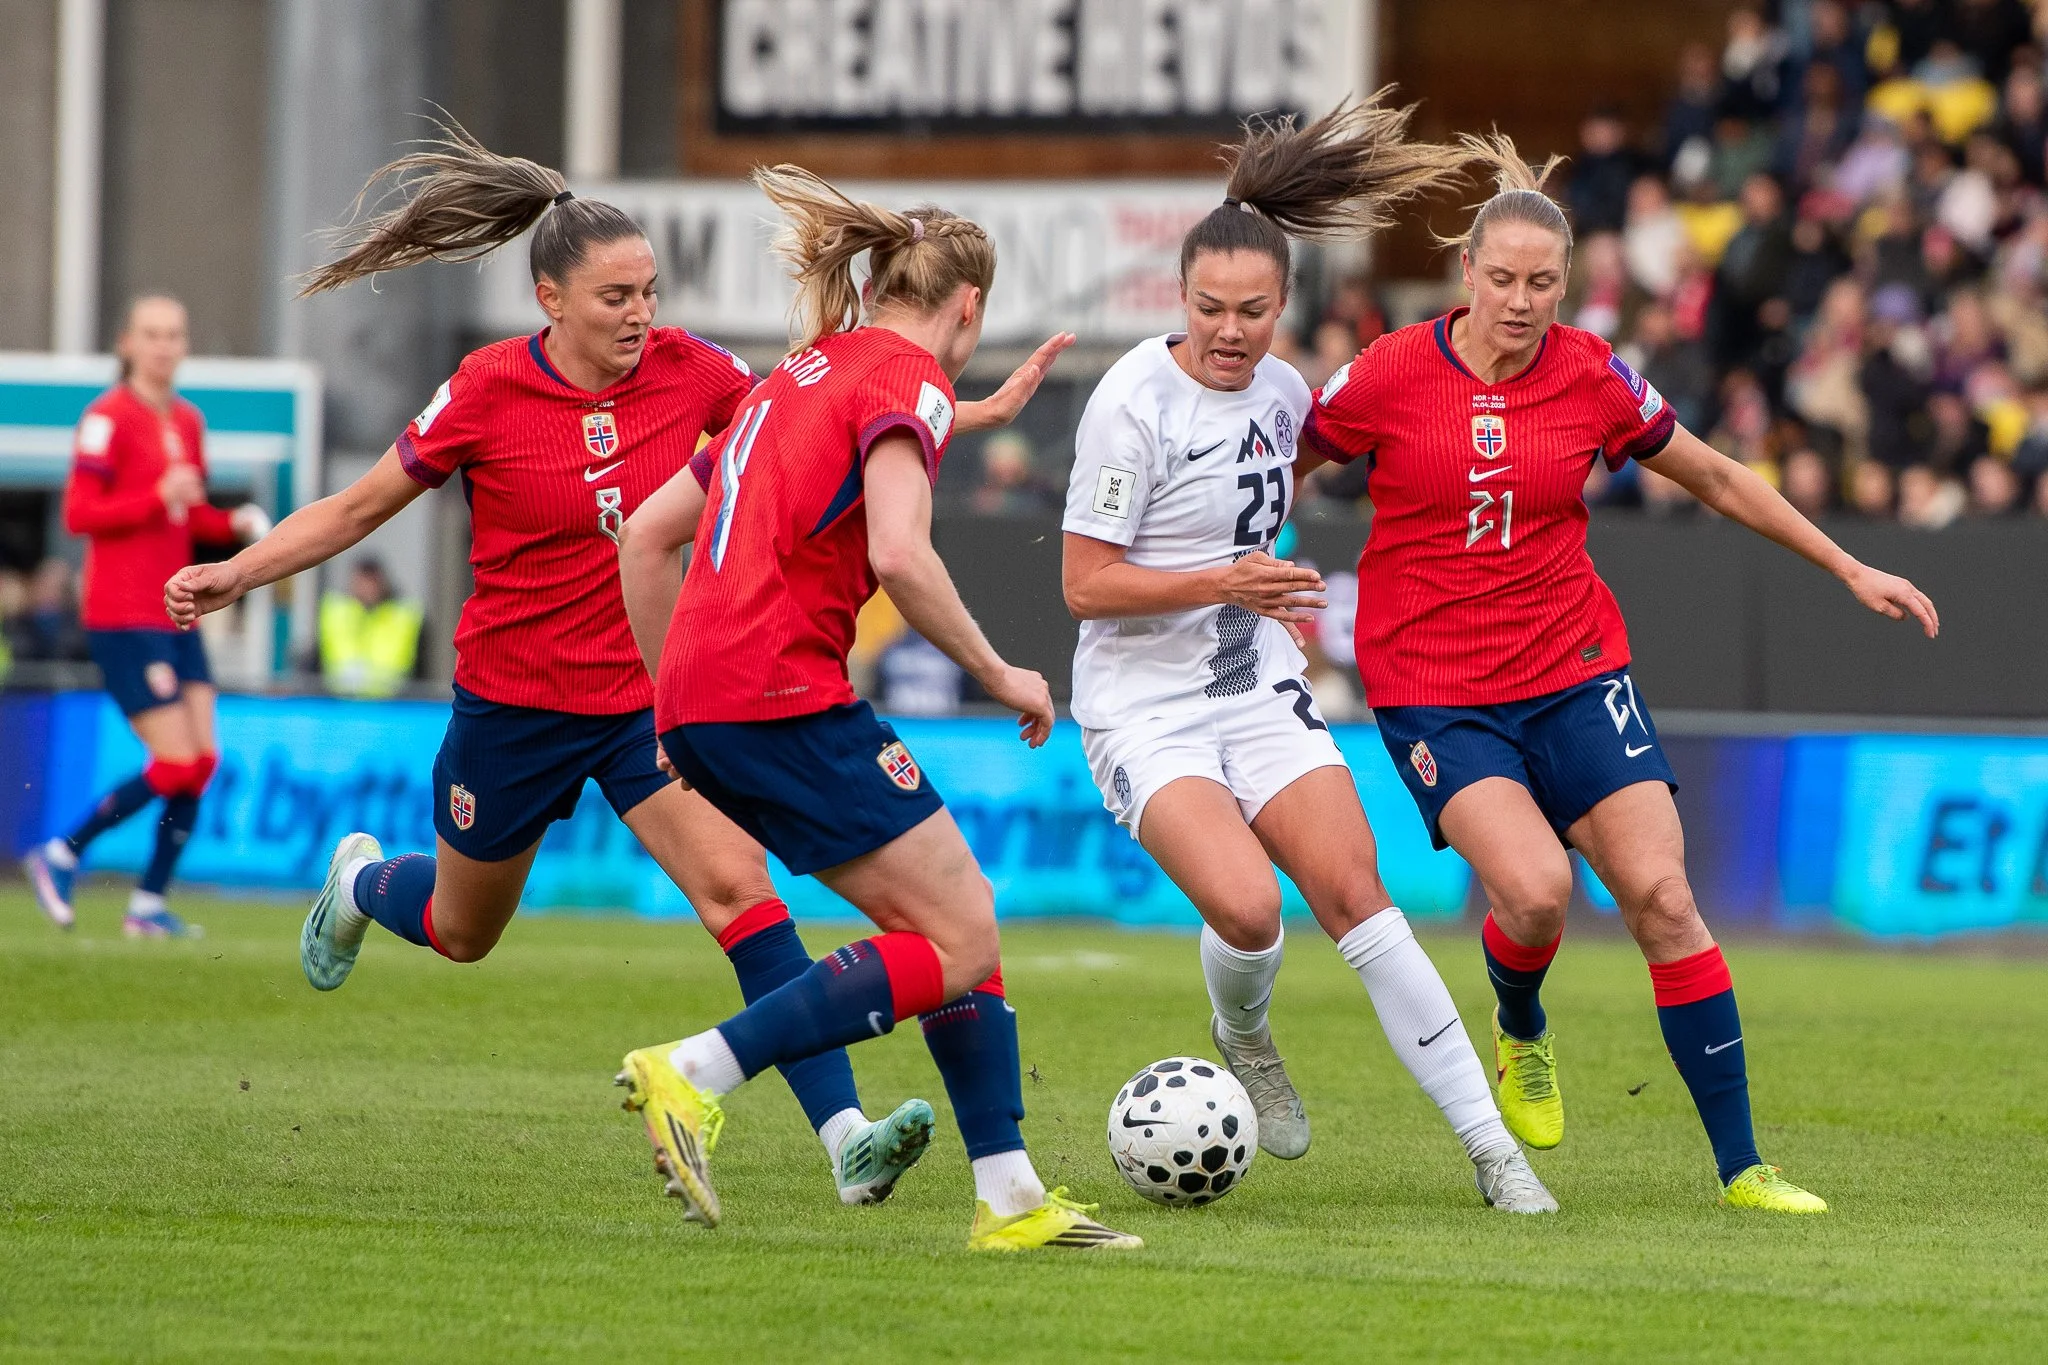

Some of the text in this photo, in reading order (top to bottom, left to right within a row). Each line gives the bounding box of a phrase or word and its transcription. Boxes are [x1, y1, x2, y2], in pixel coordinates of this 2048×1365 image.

[774, 346, 831, 387] STRA
[596, 487, 623, 546] 8
[1234, 467, 1285, 545] 23
[1466, 491, 1513, 549] 21
[1272, 679, 1329, 732] 2
[1600, 674, 1648, 735] 21
